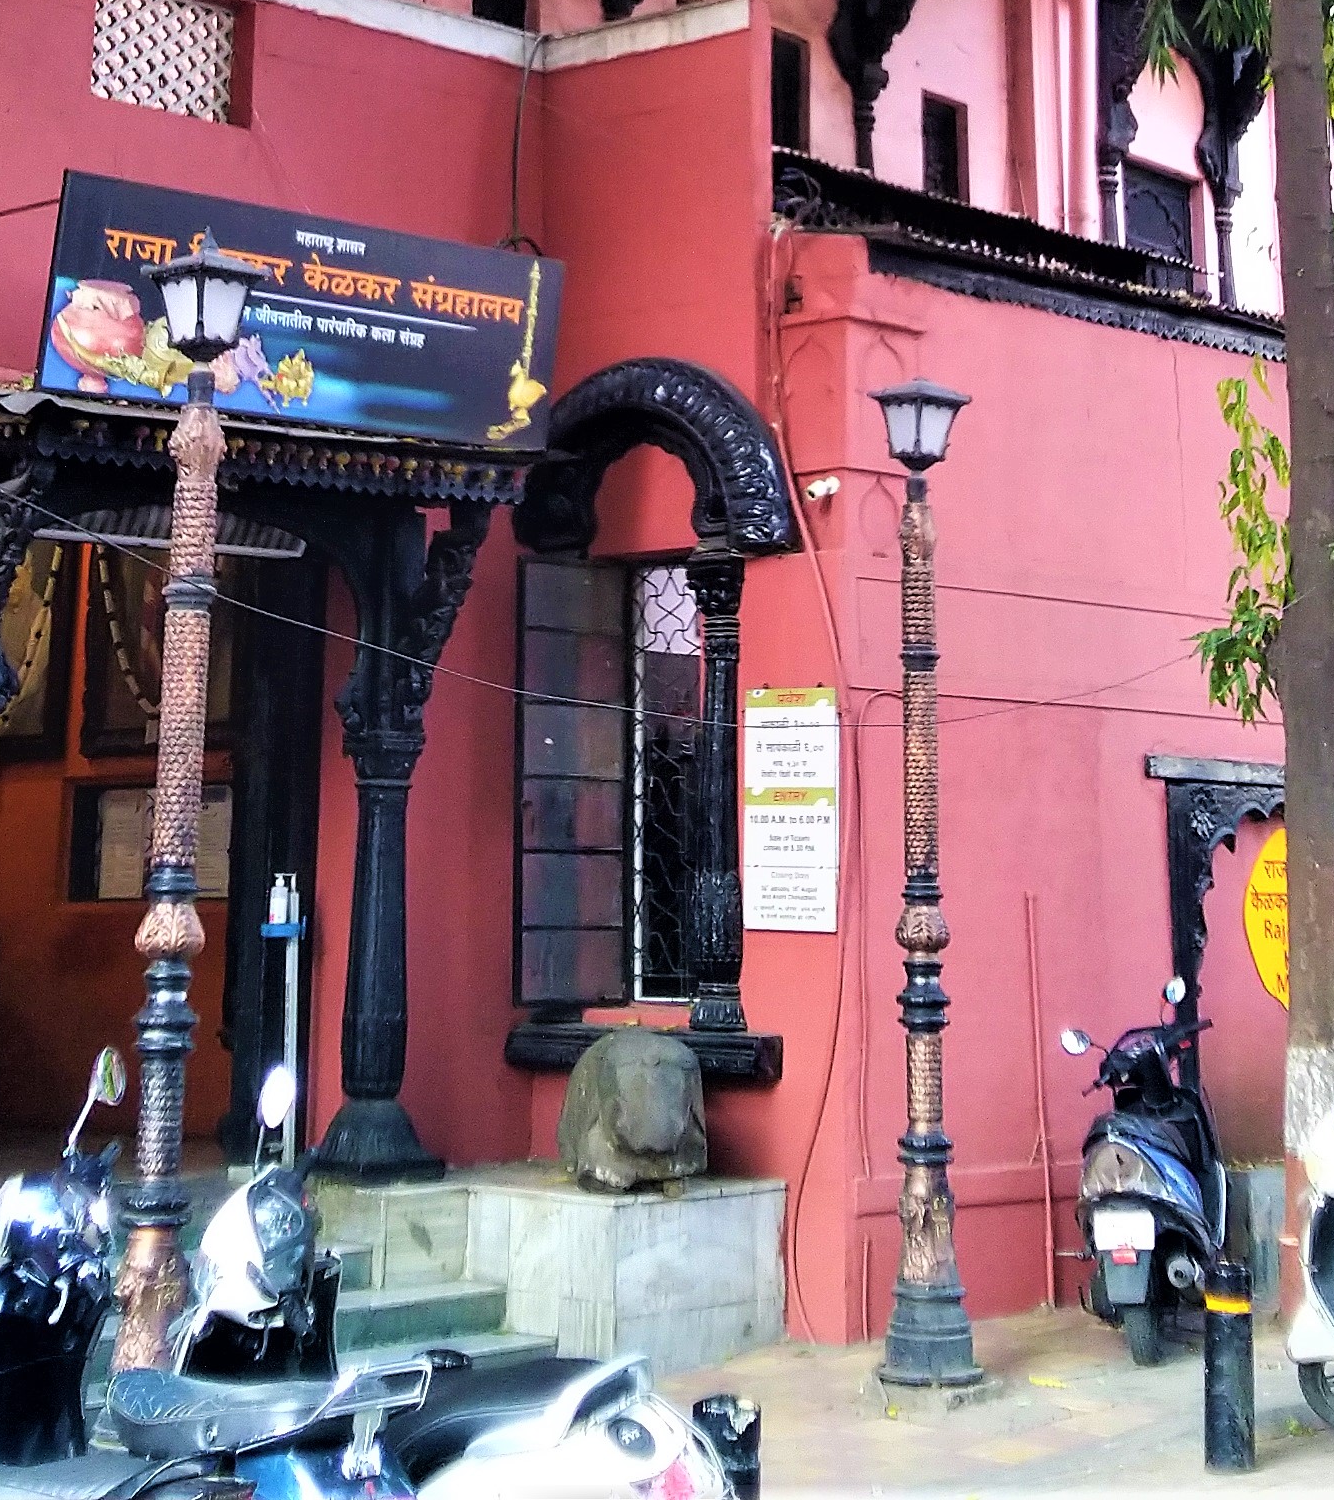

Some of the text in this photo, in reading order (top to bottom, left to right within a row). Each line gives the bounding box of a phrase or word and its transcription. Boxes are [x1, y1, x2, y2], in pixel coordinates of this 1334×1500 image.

[104, 225, 178, 265] राजा
[302, 252, 402, 305] केळकर
[410, 274, 525, 325] संग्रहालय
[1264, 918, 1286, 945] Raj
